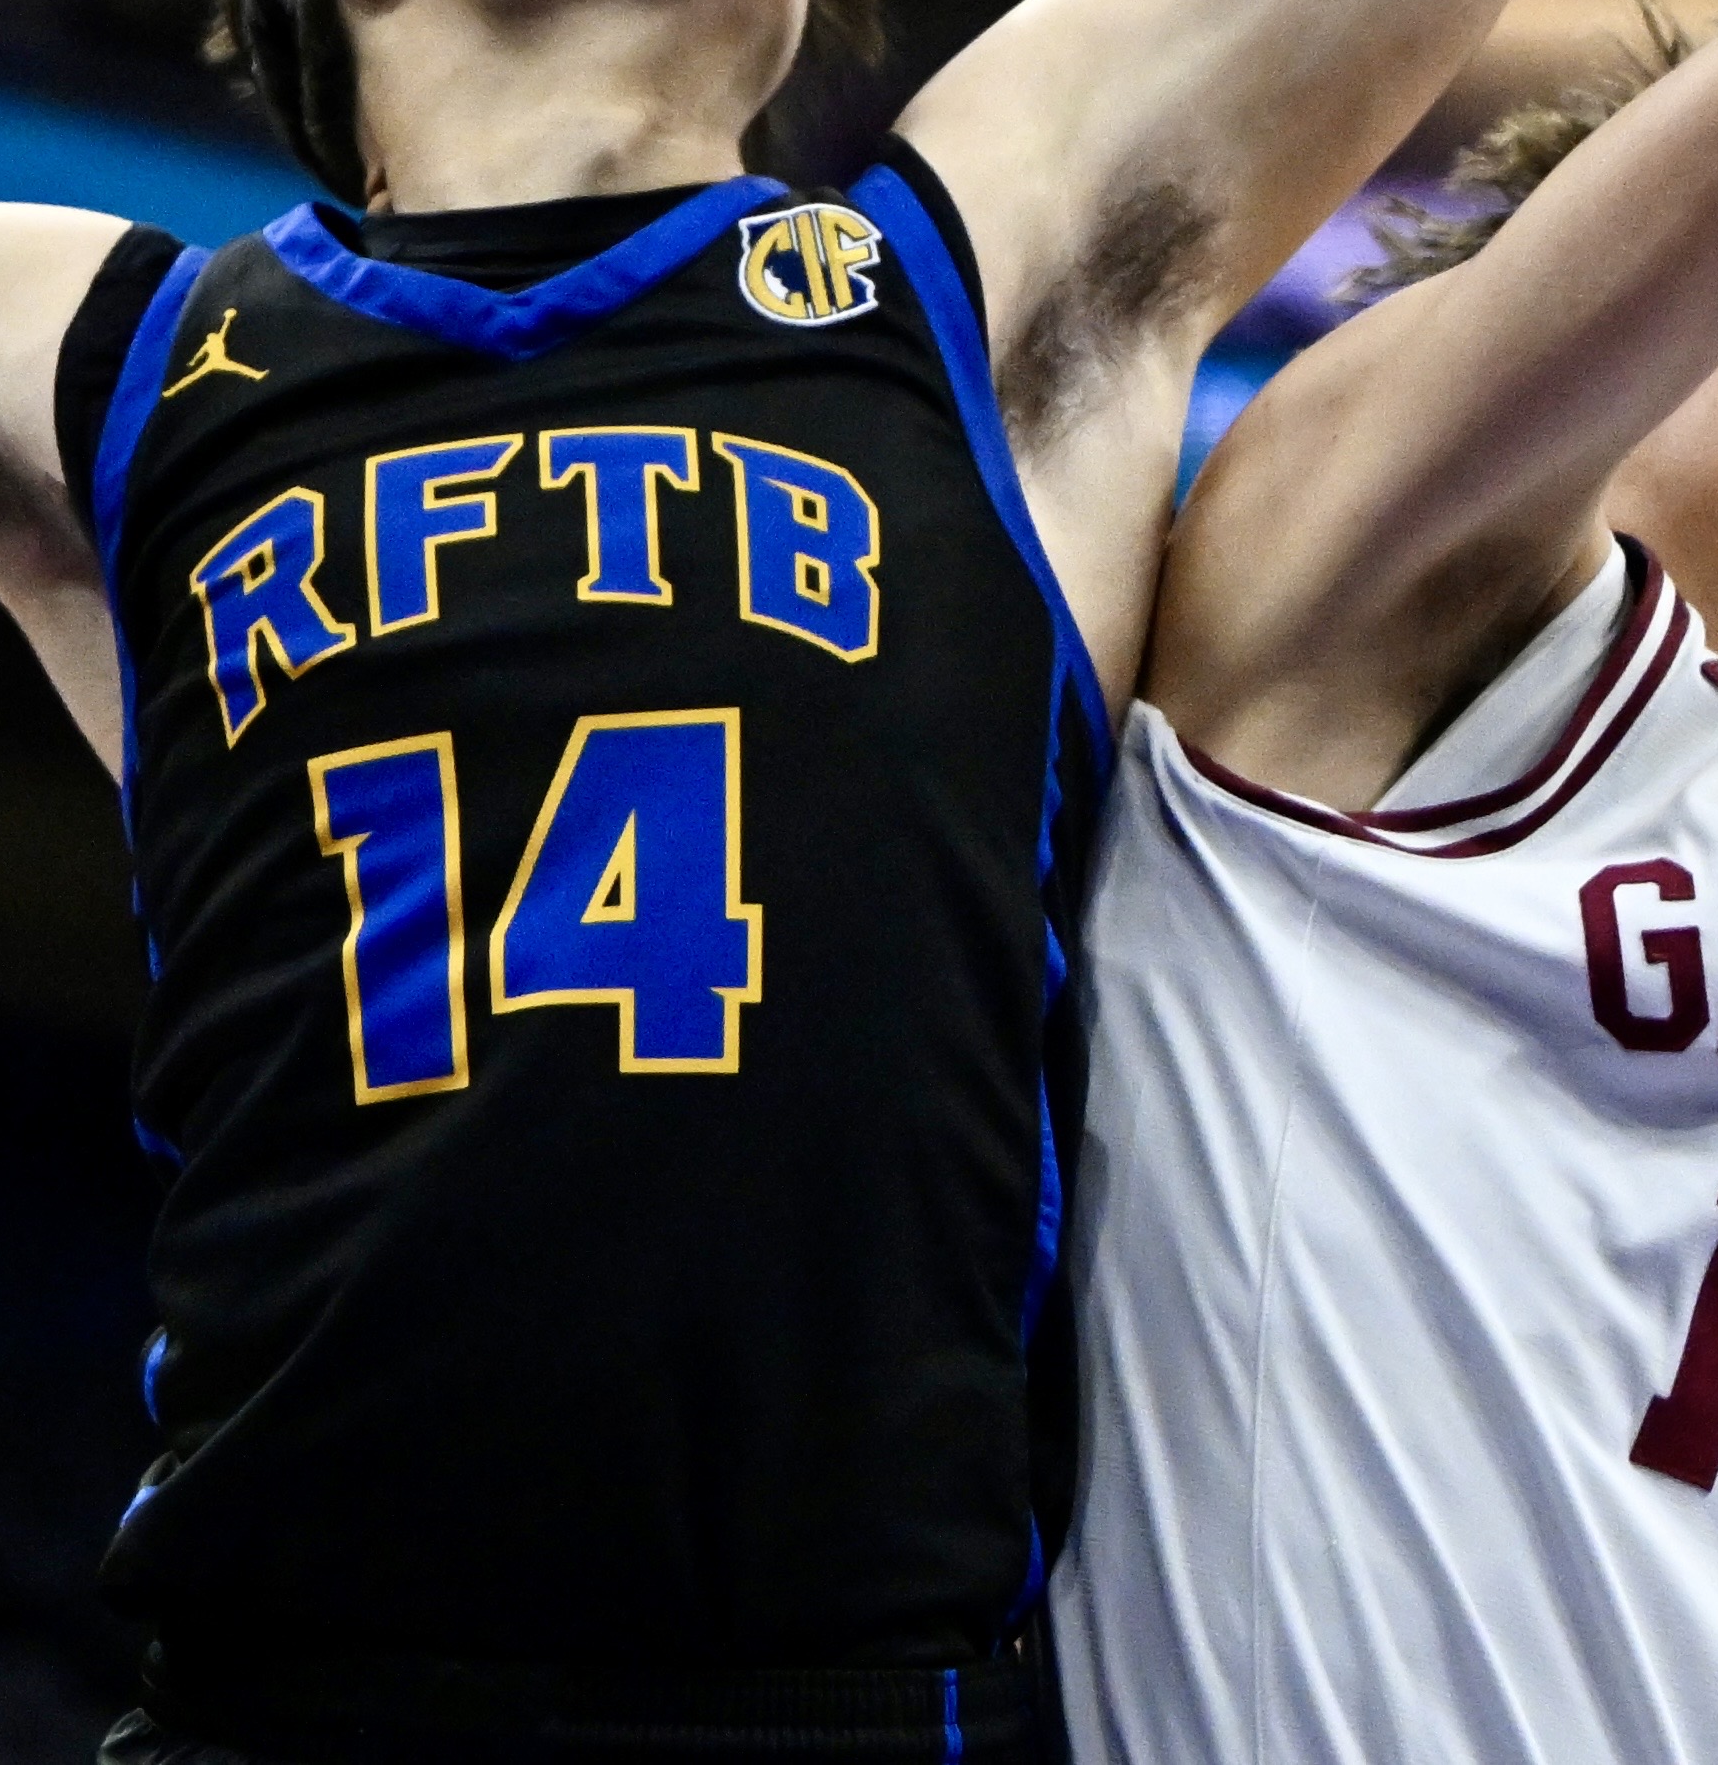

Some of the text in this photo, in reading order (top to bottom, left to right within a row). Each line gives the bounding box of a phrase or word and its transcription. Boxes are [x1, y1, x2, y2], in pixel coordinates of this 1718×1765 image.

[743, 206, 873, 320] CIF
[190, 425, 881, 748] RFTB
[307, 707, 762, 1106] 14
